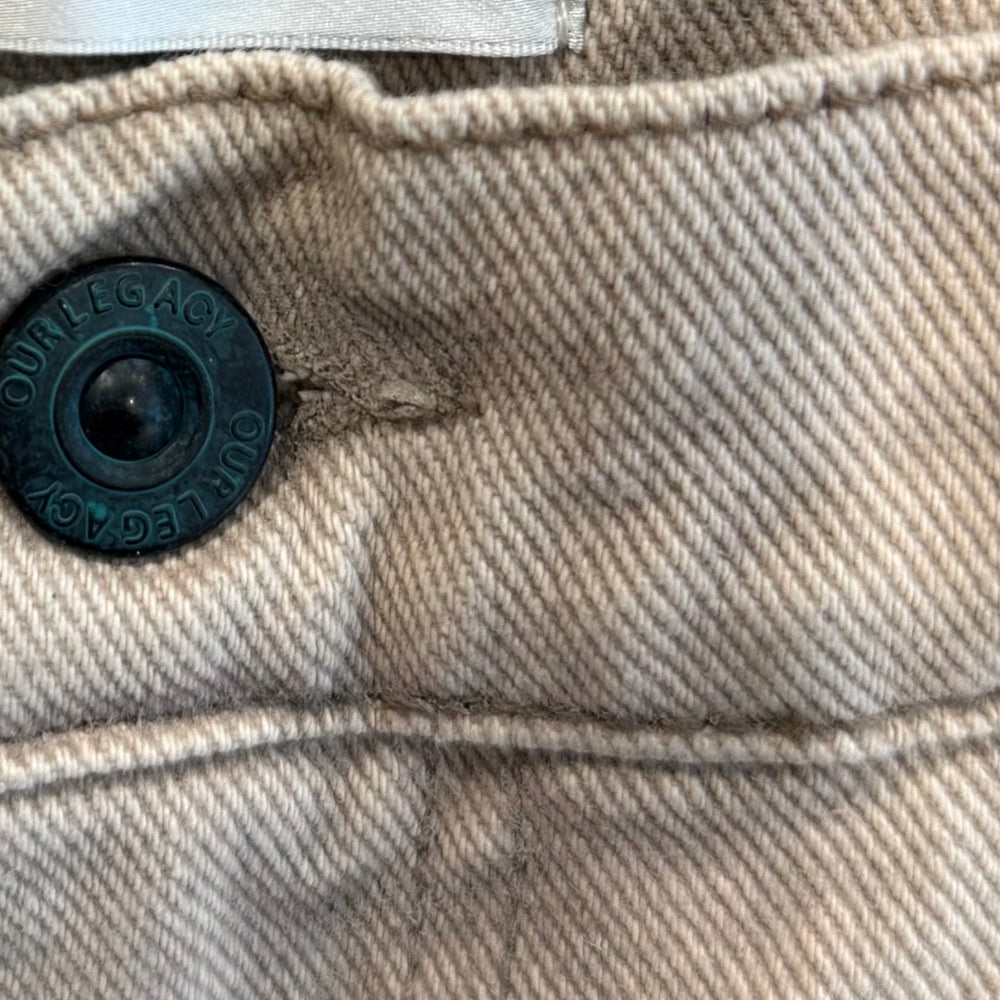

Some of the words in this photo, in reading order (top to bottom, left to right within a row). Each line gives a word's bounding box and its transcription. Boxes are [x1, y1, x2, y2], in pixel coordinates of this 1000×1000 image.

[58, 271, 238, 338] LEGACY
[211, 409, 265, 500] OUR
[27, 481, 209, 545] LEGACY
